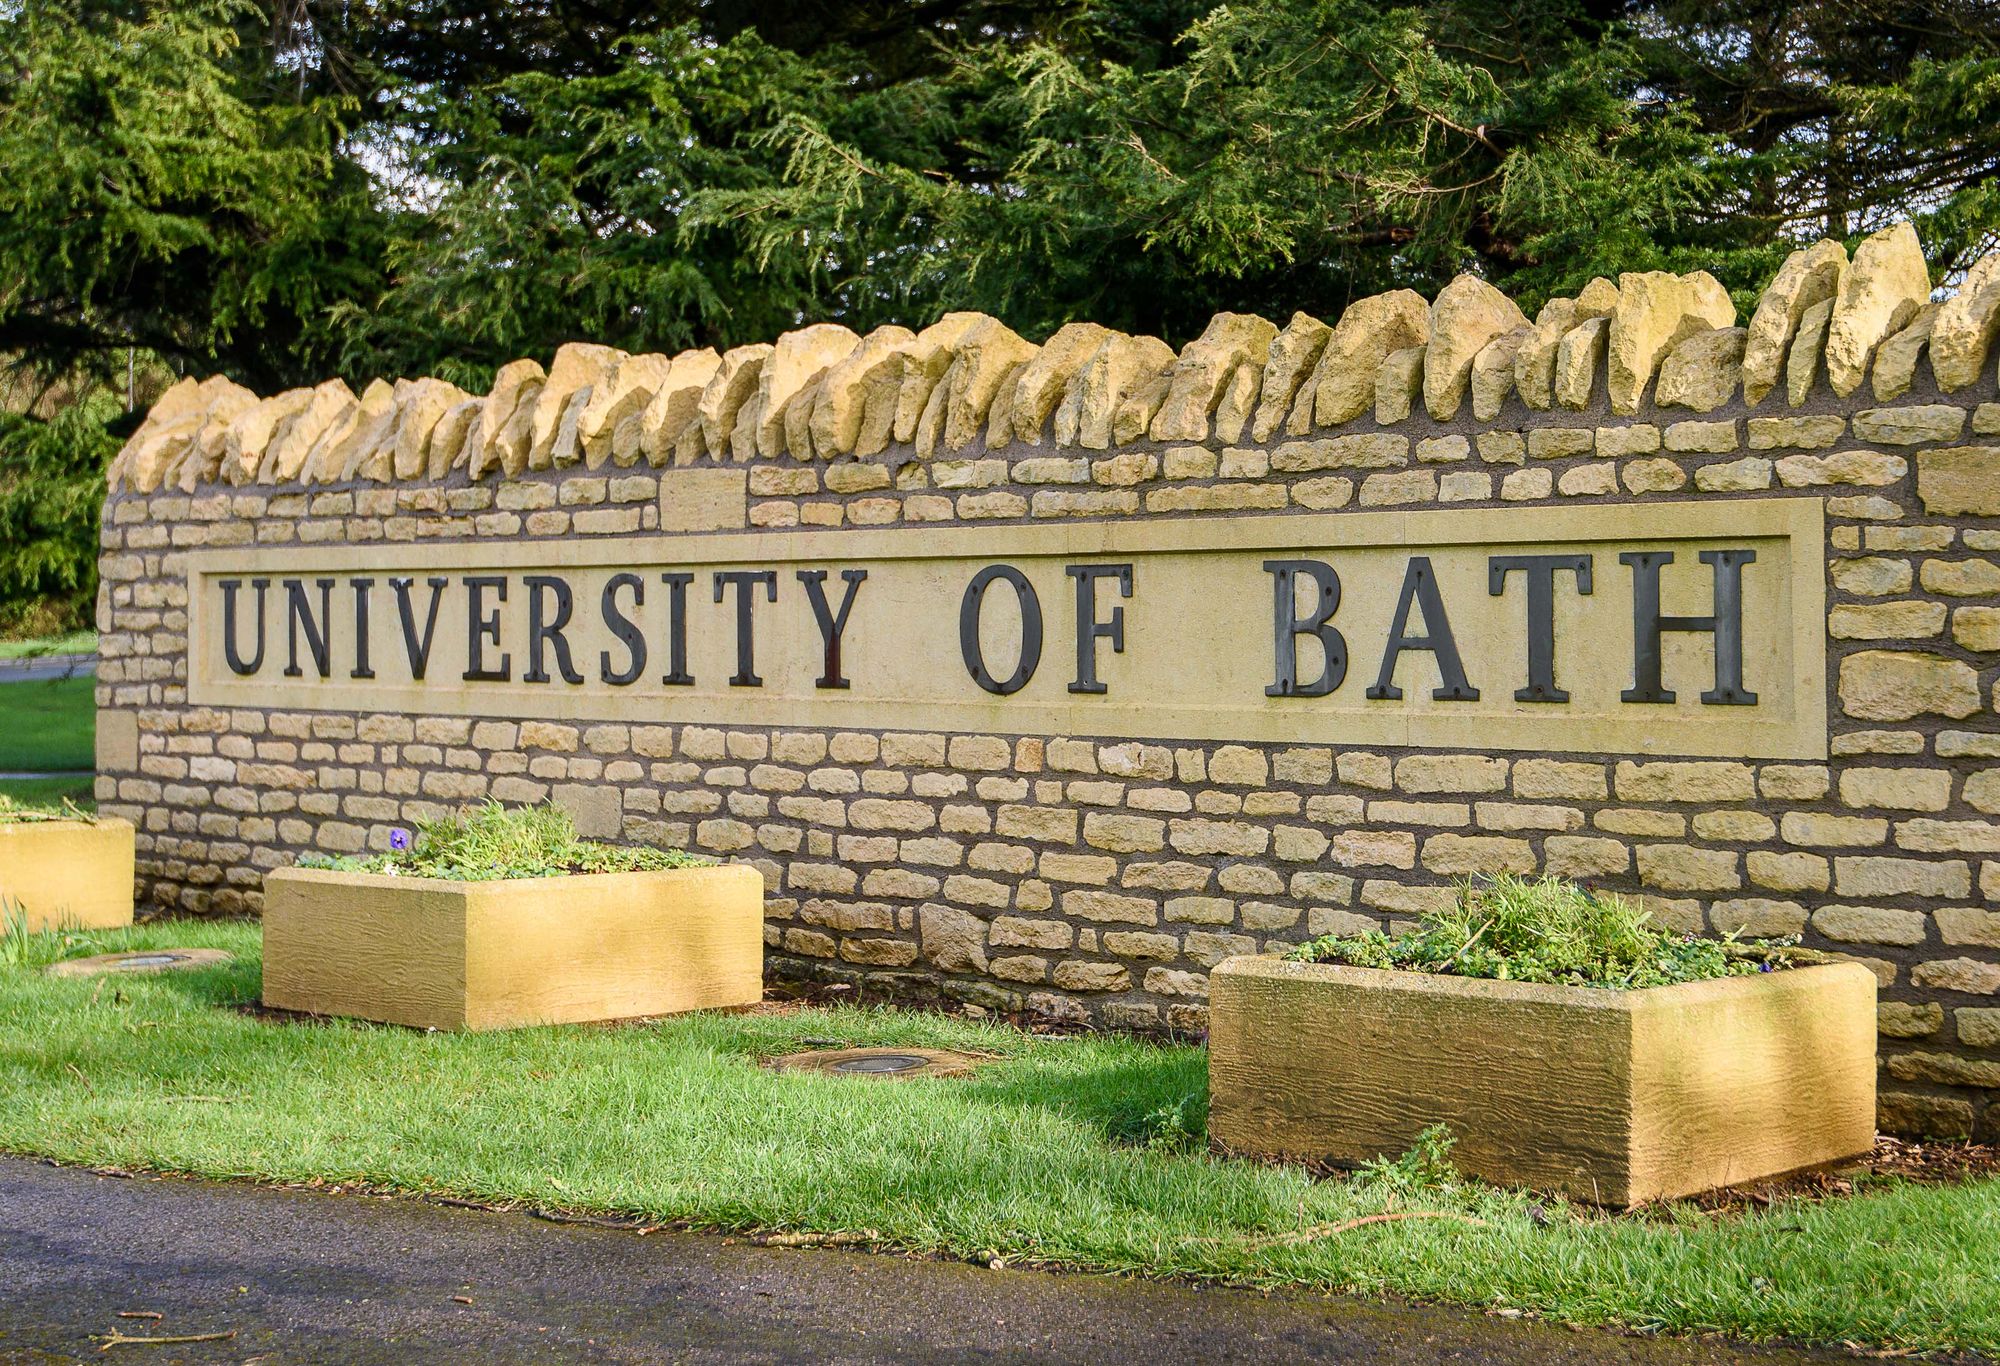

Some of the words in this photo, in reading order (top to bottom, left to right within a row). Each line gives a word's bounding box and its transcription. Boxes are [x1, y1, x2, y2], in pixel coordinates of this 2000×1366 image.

[219, 570, 868, 690] UNIVERSITY
[960, 564, 1133, 697] OF
[1263, 550, 1758, 706] BATH
